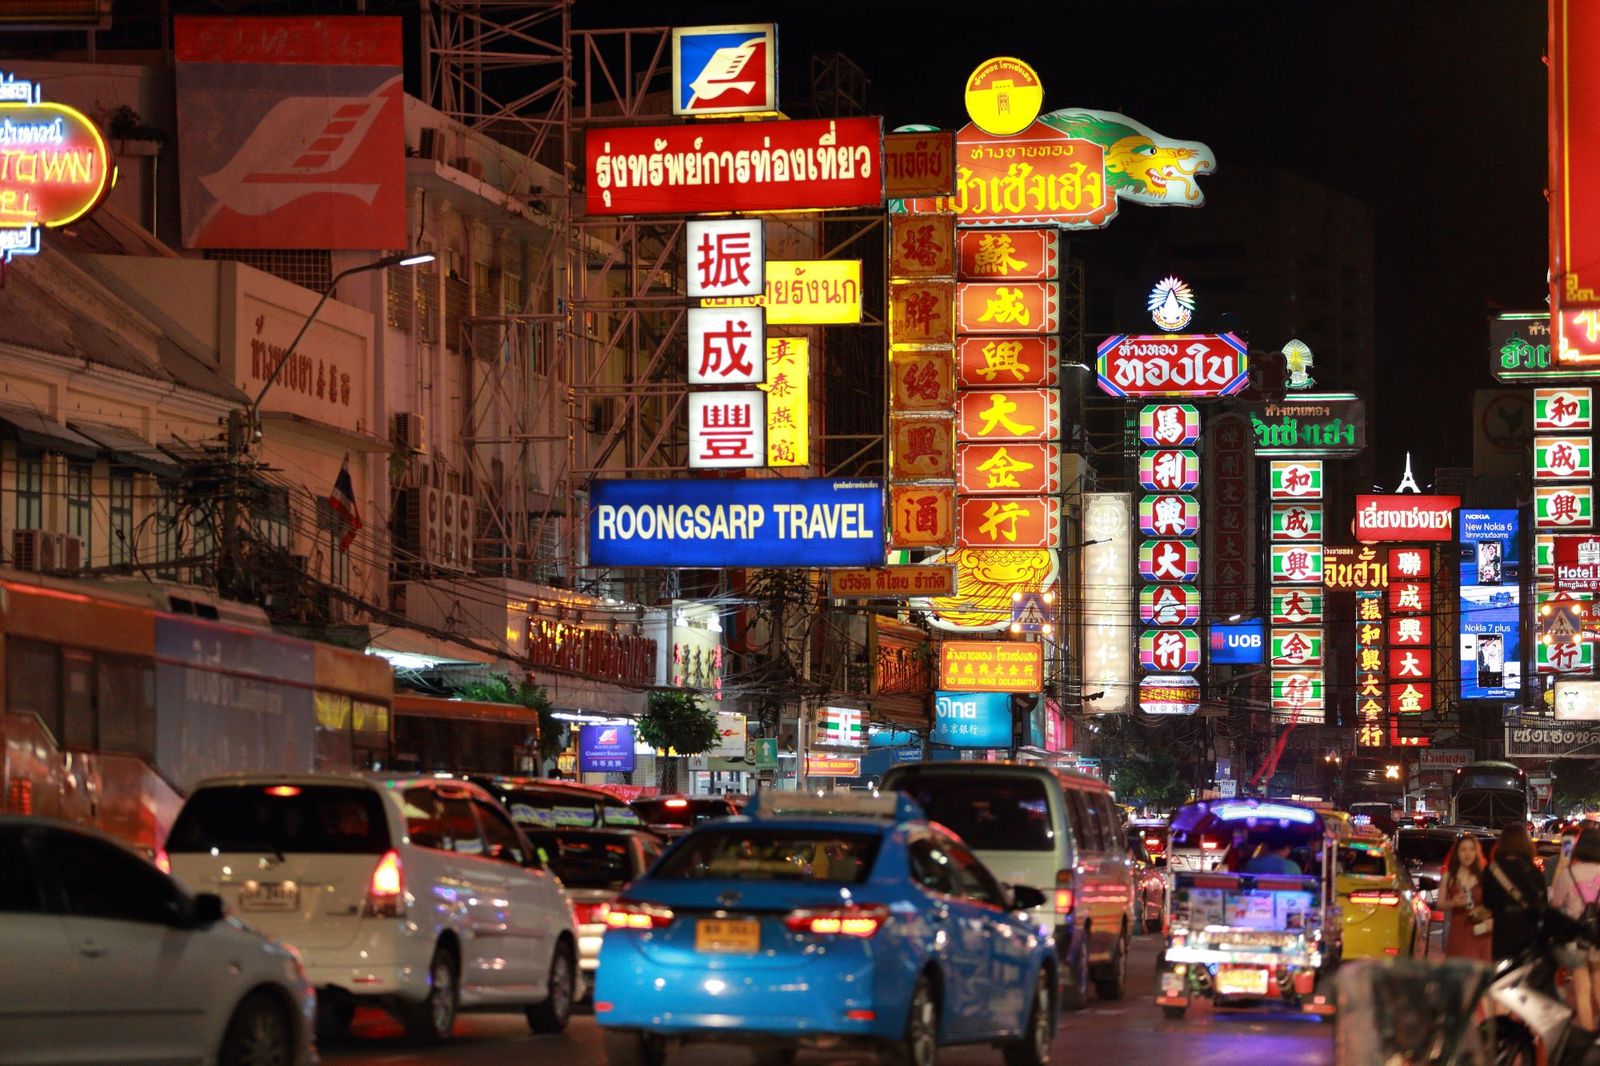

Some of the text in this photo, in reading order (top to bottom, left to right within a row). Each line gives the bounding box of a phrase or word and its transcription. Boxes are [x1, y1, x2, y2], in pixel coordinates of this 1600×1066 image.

[596, 121, 871, 207] รุ่งทรัพย์การท่องเที่ยว
[885, 140, 942, 178] าเจดีย์
[697, 232, 754, 460] 振成豐
[1118, 339, 1178, 357] ห้างทอง
[1113, 343, 1233, 387] ทองใบ
[974, 233, 1037, 542] 蘇成興大金行
[598, 503, 874, 540] ROONGSARP TRAVEL
[1465, 522, 1513, 531] New Nokia 6
[1283, 467, 1312, 703] 和成興大金行
[1558, 565, 1593, 578] Hotel
[1228, 634, 1262, 647] UOB
[1464, 624, 1511, 634] Nokia 7 plus
[1397, 552, 1423, 745] 聯成興大金
[1140, 688, 1198, 701] EXCHANGE
